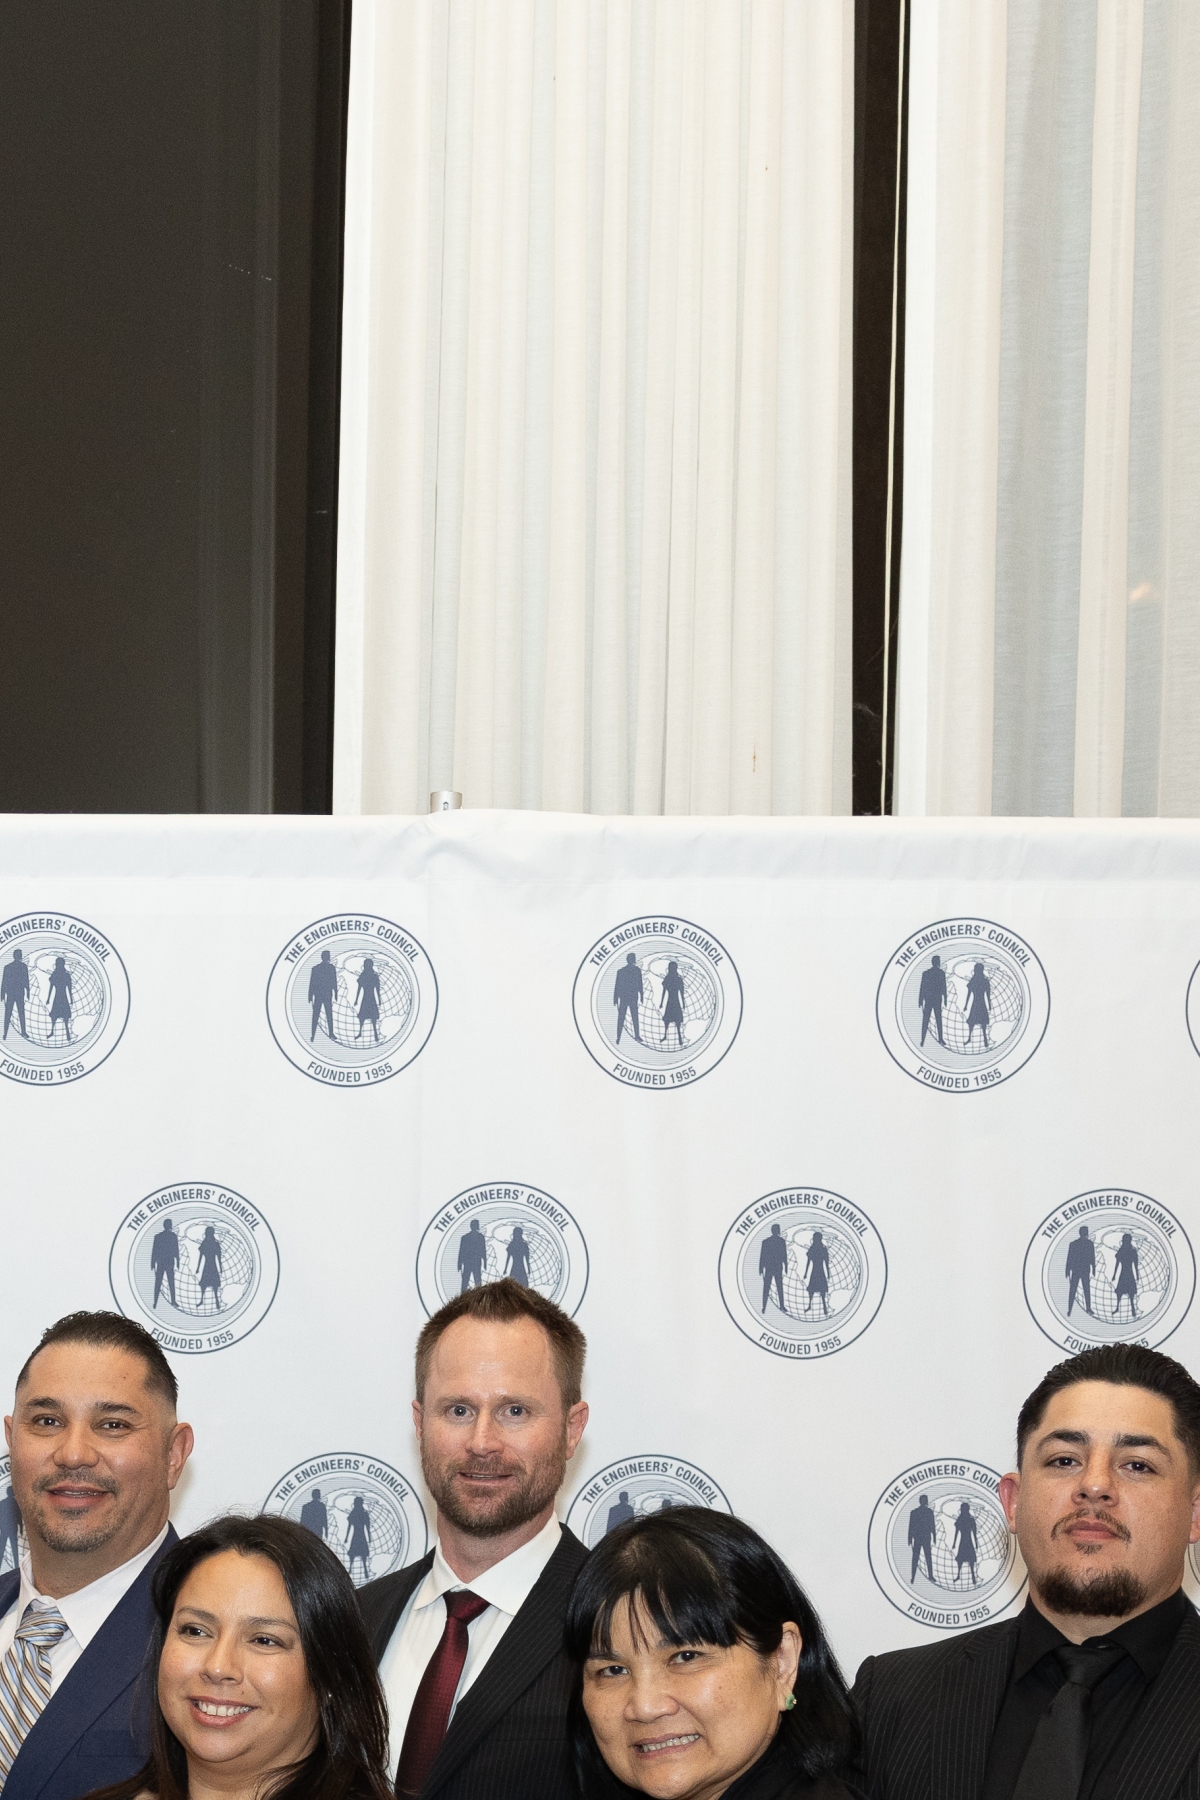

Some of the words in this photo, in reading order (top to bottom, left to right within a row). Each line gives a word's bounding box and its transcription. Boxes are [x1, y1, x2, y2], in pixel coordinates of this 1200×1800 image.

[68, 923, 111, 963] COUNCIL
[284, 941, 306, 964] THE
[303, 919, 375, 946] ENGINEERS'
[376, 925, 419, 963] COUNCIL
[589, 944, 611, 967] THE
[608, 921, 680, 949] ENGINEERS'
[681, 927, 724, 967] COUNCIL
[894, 945, 917, 968] THE
[914, 924, 986, 950] ENGINEERS'
[987, 929, 1031, 968] COUNCIL
[0, 1058, 54, 1082] FOUNDED
[57, 1061, 85, 1080] 1955
[307, 1060, 361, 1083] FOUNDED
[364, 1062, 393, 1081] 1955
[612, 1063, 666, 1086] FOUNDED
[669, 1066, 697, 1084] 1955
[916, 1065, 970, 1089] FOUNDED
[973, 1067, 1002, 1087] 1955
[126, 1209, 149, 1231] THE
[145, 1188, 216, 1214] ENGINEERS'
[217, 1193, 260, 1232] COUNCIL
[433, 1210, 456, 1233] THE
[453, 1188, 524, 1215] ENGINEERS'
[526, 1193, 570, 1232] COUNCIL
[735, 1214, 757, 1236] THE
[753, 1193, 824, 1219] ENGINEERS'
[825, 1198, 868, 1238] COUNCIL
[1041, 1216, 1064, 1239] THE
[1061, 1194, 1134, 1221] ENGINEERS'
[1135, 1200, 1177, 1239] COUNCIL
[206, 1329, 234, 1348] 1955
[758, 1332, 811, 1355] FOUNDED
[814, 1335, 842, 1354] 1955
[274, 1479, 297, 1501] THE
[294, 1458, 365, 1484] ENGINEERS'
[366, 1463, 409, 1503] COUNCIL
[581, 1482, 604, 1504] THE
[601, 1460, 673, 1487] ENGINEERS'
[675, 1466, 718, 1505] COUNCIL
[883, 1485, 905, 1507] THE
[901, 1464, 971, 1490] ENGINEERS'
[972, 1469, 999, 1494] COUN
[907, 1602, 960, 1625] FOUNDED
[963, 1604, 991, 1623] 1955
